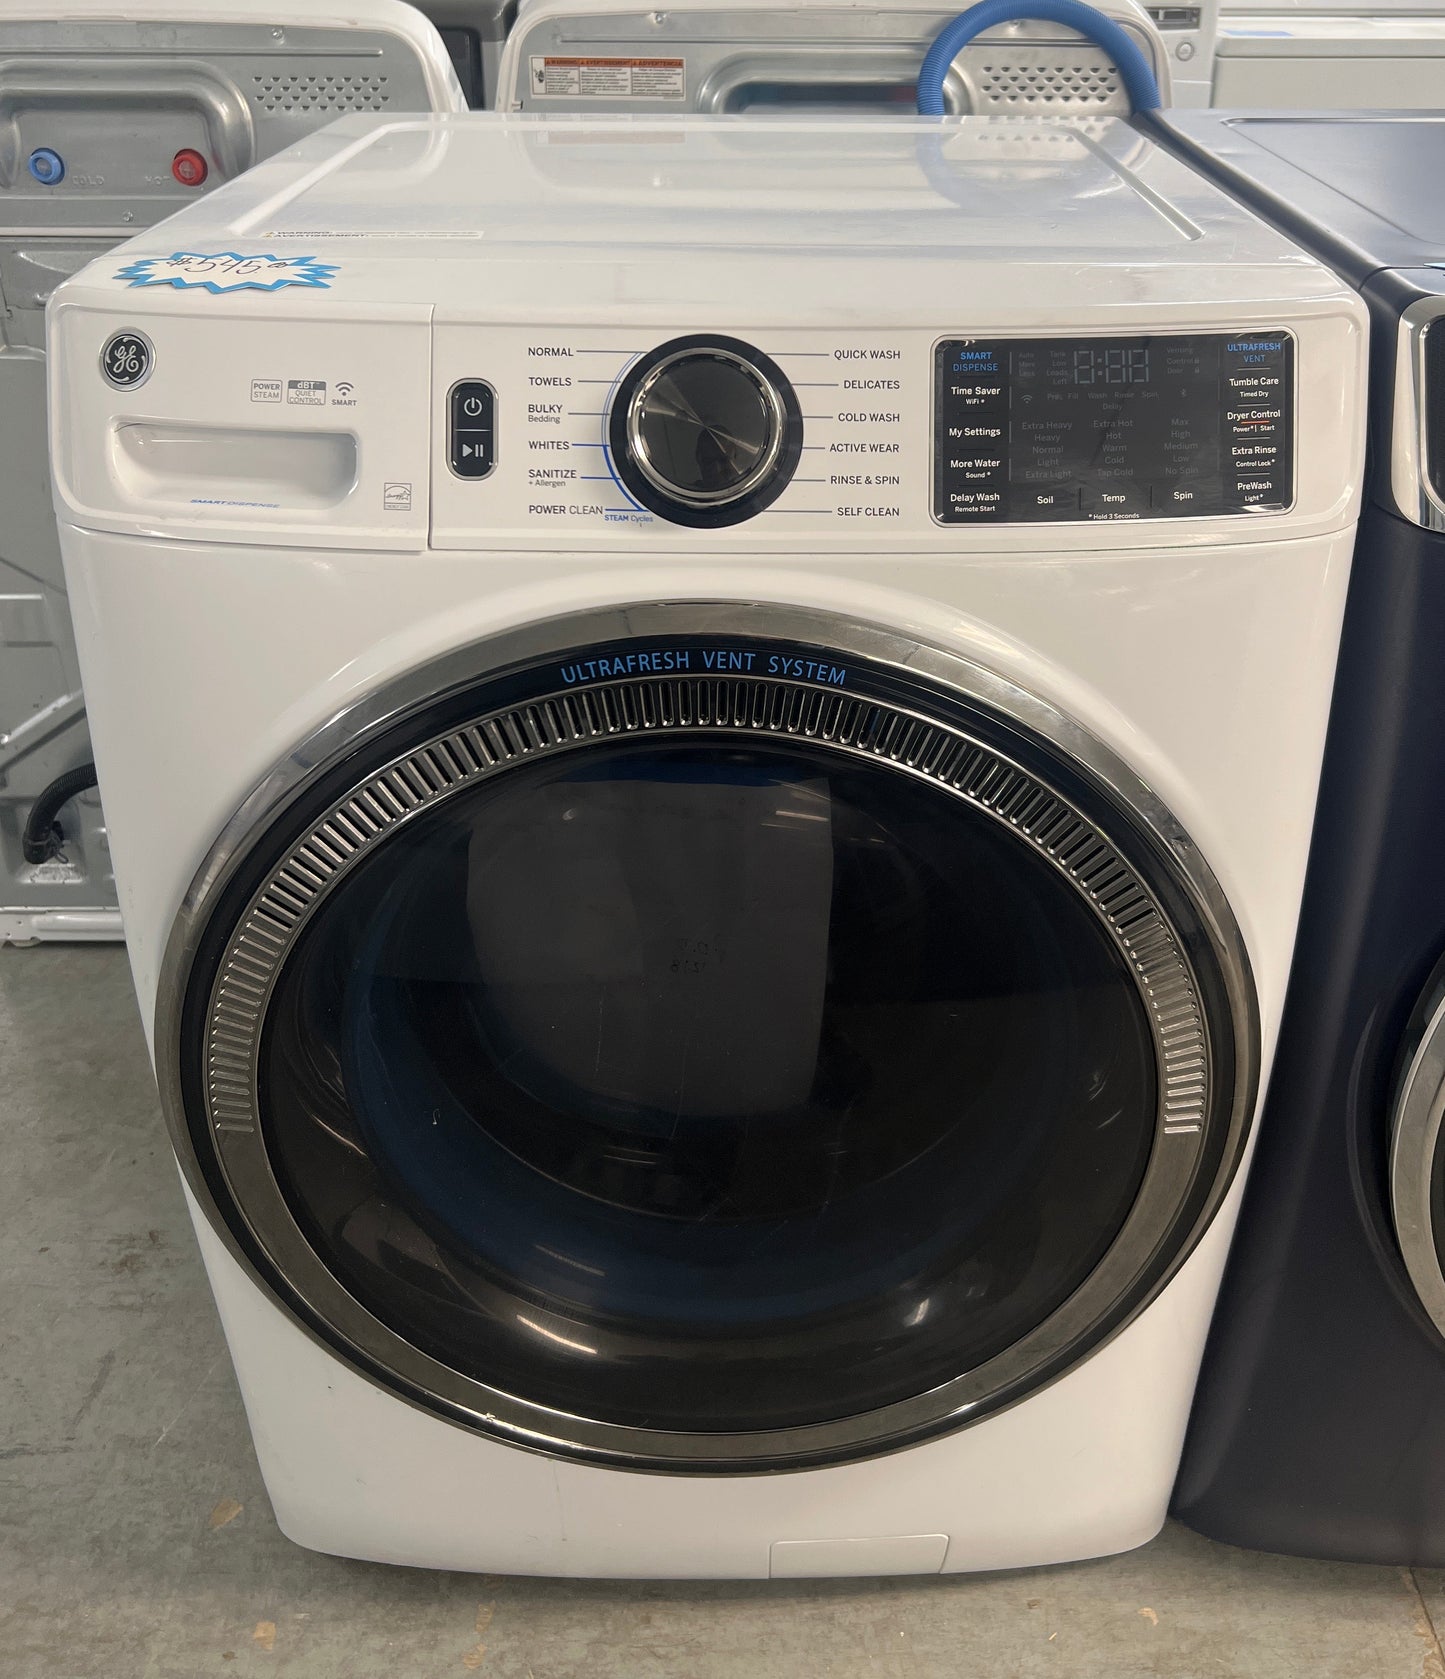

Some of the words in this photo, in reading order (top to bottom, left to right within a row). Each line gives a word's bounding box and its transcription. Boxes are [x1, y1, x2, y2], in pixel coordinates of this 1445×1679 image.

[528, 347, 574, 356] NORMAL
[1227, 342, 1281, 352] ULTRAFRESH
[834, 350, 867, 360] QUICK
[870, 350, 901, 359] WASH
[960, 351, 993, 360] SMART
[1243, 354, 1266, 363] VENT
[953, 363, 999, 372] DISPENSE
[529, 377, 572, 386] TOWELS
[843, 380, 900, 389] DELICATES
[1229, 377, 1259, 386] Tumble
[1260, 376, 1279, 385] Care
[253, 383, 281, 391] POWER
[951, 386, 972, 395] Time
[975, 386, 1001, 395] Saver
[253, 391, 280, 399] STEAM
[1087, 391, 1108, 399] Wash
[1258, 390, 1269, 398] Dry
[331, 398, 358, 406] SMART
[1102, 402, 1123, 410] Delay
[528, 404, 563, 413] BULKY
[528, 415, 561, 424] Bedding
[838, 412, 867, 422] COLD
[869, 413, 900, 422] WASH
[1227, 411, 1250, 421] Dryer
[1250, 409, 1281, 419] Control
[1022, 421, 1044, 430] Extra
[1046, 421, 1073, 431] Heavy
[1093, 419, 1115, 428] Extra
[1117, 418, 1134, 427] Hot
[1171, 418, 1189, 426] Max
[949, 427, 963, 437] My
[964, 427, 1001, 437] Settings
[1105, 431, 1122, 440] Hot
[1170, 430, 1191, 440] High
[1034, 433, 1061, 443] Heavy
[528, 440, 570, 450] WHITES
[829, 443, 867, 453] ACTIVE
[869, 443, 900, 453] WEAR
[1032, 445, 1064, 454] Normal
[1102, 443, 1128, 452] Warm
[1163, 441, 1199, 450] Medium
[1232, 447, 1253, 456] Extra
[1254, 446, 1277, 454] Rinse
[1037, 457, 1060, 467] Light
[1104, 456, 1125, 465] Cold
[1172, 454, 1189, 462] Low
[950, 459, 973, 468] More
[974, 459, 1001, 468] Water
[528, 469, 577, 479] SANITIZE
[1025, 470, 1048, 479] Extra
[1049, 469, 1073, 480] Light
[1113, 467, 1134, 476] Cold
[1165, 466, 1177, 474] No
[1179, 465, 1199, 475] Spin
[965, 471, 986, 479] Sound
[534, 480, 566, 488] Allergen
[830, 475, 862, 485] RINSE
[864, 475, 872, 485] &
[875, 475, 900, 485] SPIN
[1237, 481, 1272, 491] PreWash
[950, 493, 975, 503] Delay
[976, 492, 1000, 501] Wash
[1037, 495, 1054, 504] Soil
[1102, 494, 1126, 503] Temp
[1173, 491, 1193, 501] Spin
[1245, 495, 1260, 503] Light
[528, 505, 566, 514] POWER
[569, 505, 604, 515] CLEAN
[837, 507, 862, 516] SELF
[864, 507, 900, 517] CLEAN
[604, 514, 629, 522] STEAM
[630, 515, 654, 523] Cycles
[560, 651, 690, 684] ULTRAFRESH
[702, 651, 756, 671] VENT
[767, 655, 847, 686] SYSTEM
